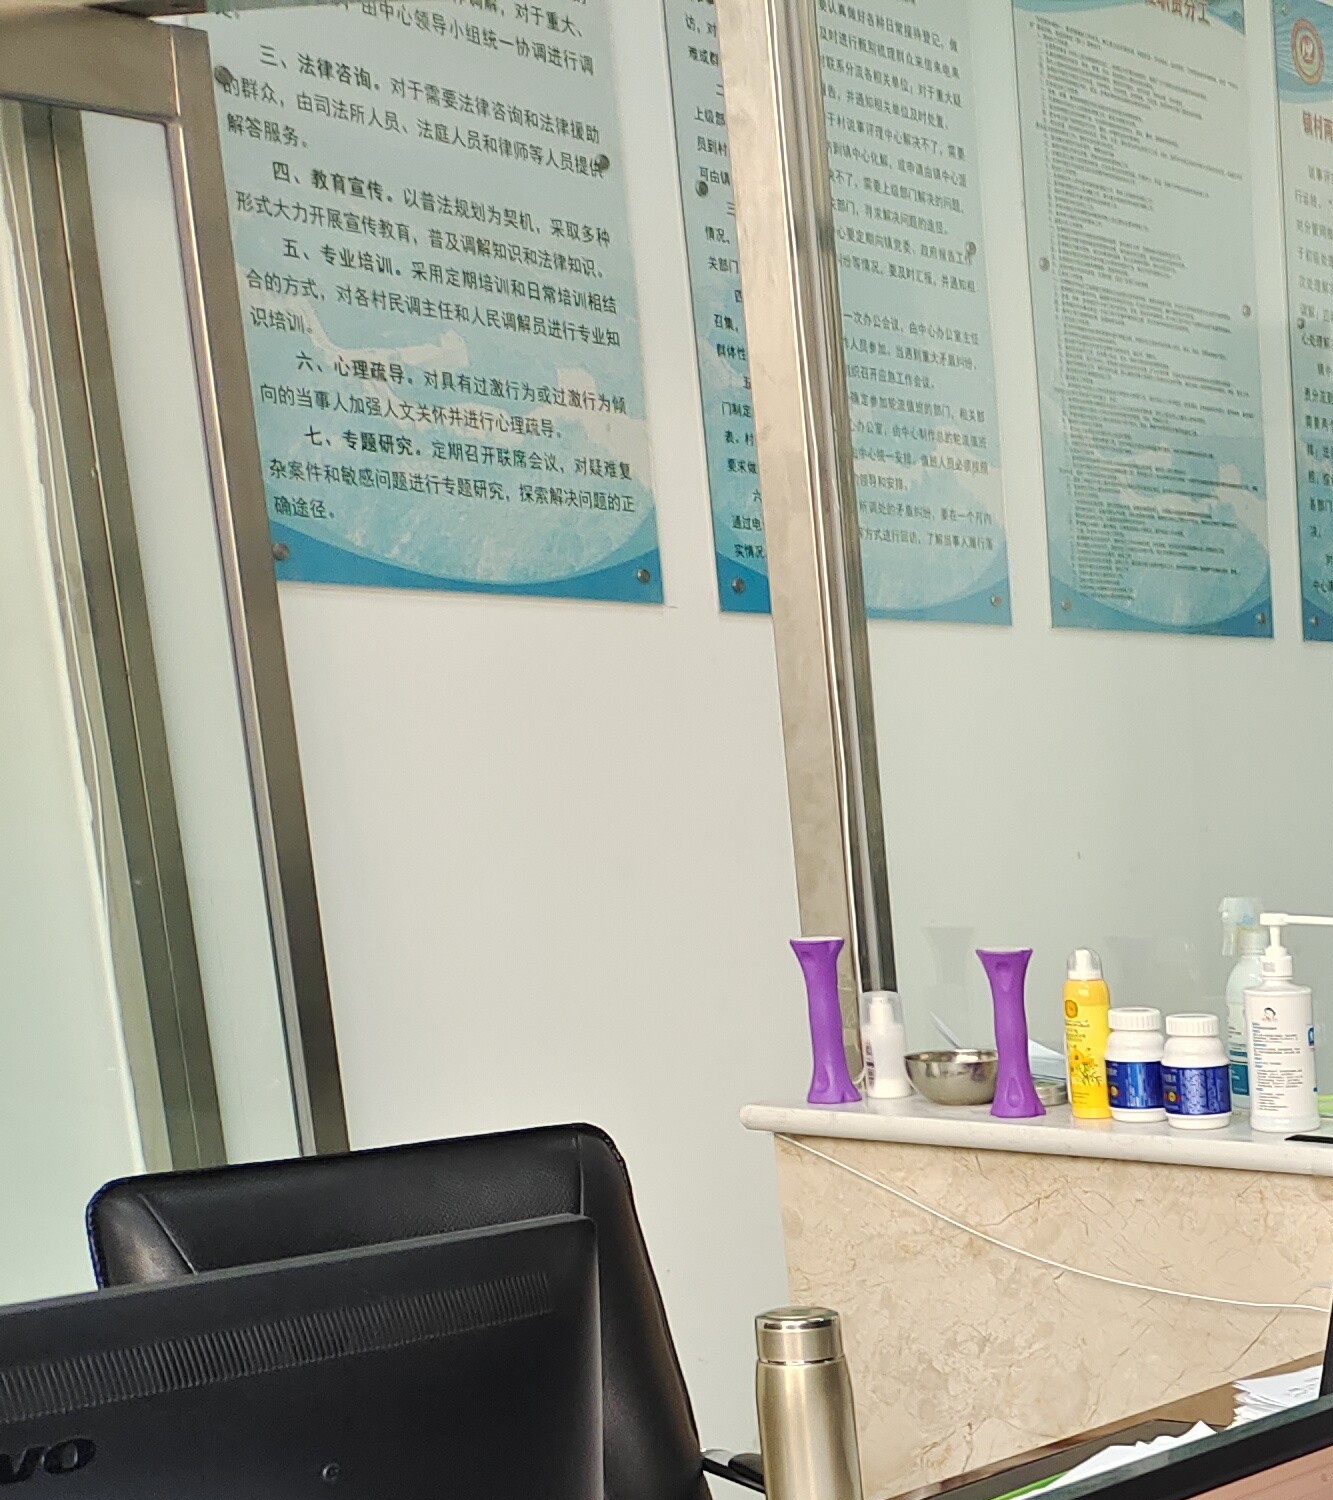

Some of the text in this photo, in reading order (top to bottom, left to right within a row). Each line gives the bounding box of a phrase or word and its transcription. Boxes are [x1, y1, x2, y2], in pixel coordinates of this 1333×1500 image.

[227, 113, 311, 150] 解答服务。
[249, 306, 316, 335] 识培训。
[273, 496, 336, 521] 确途径。
